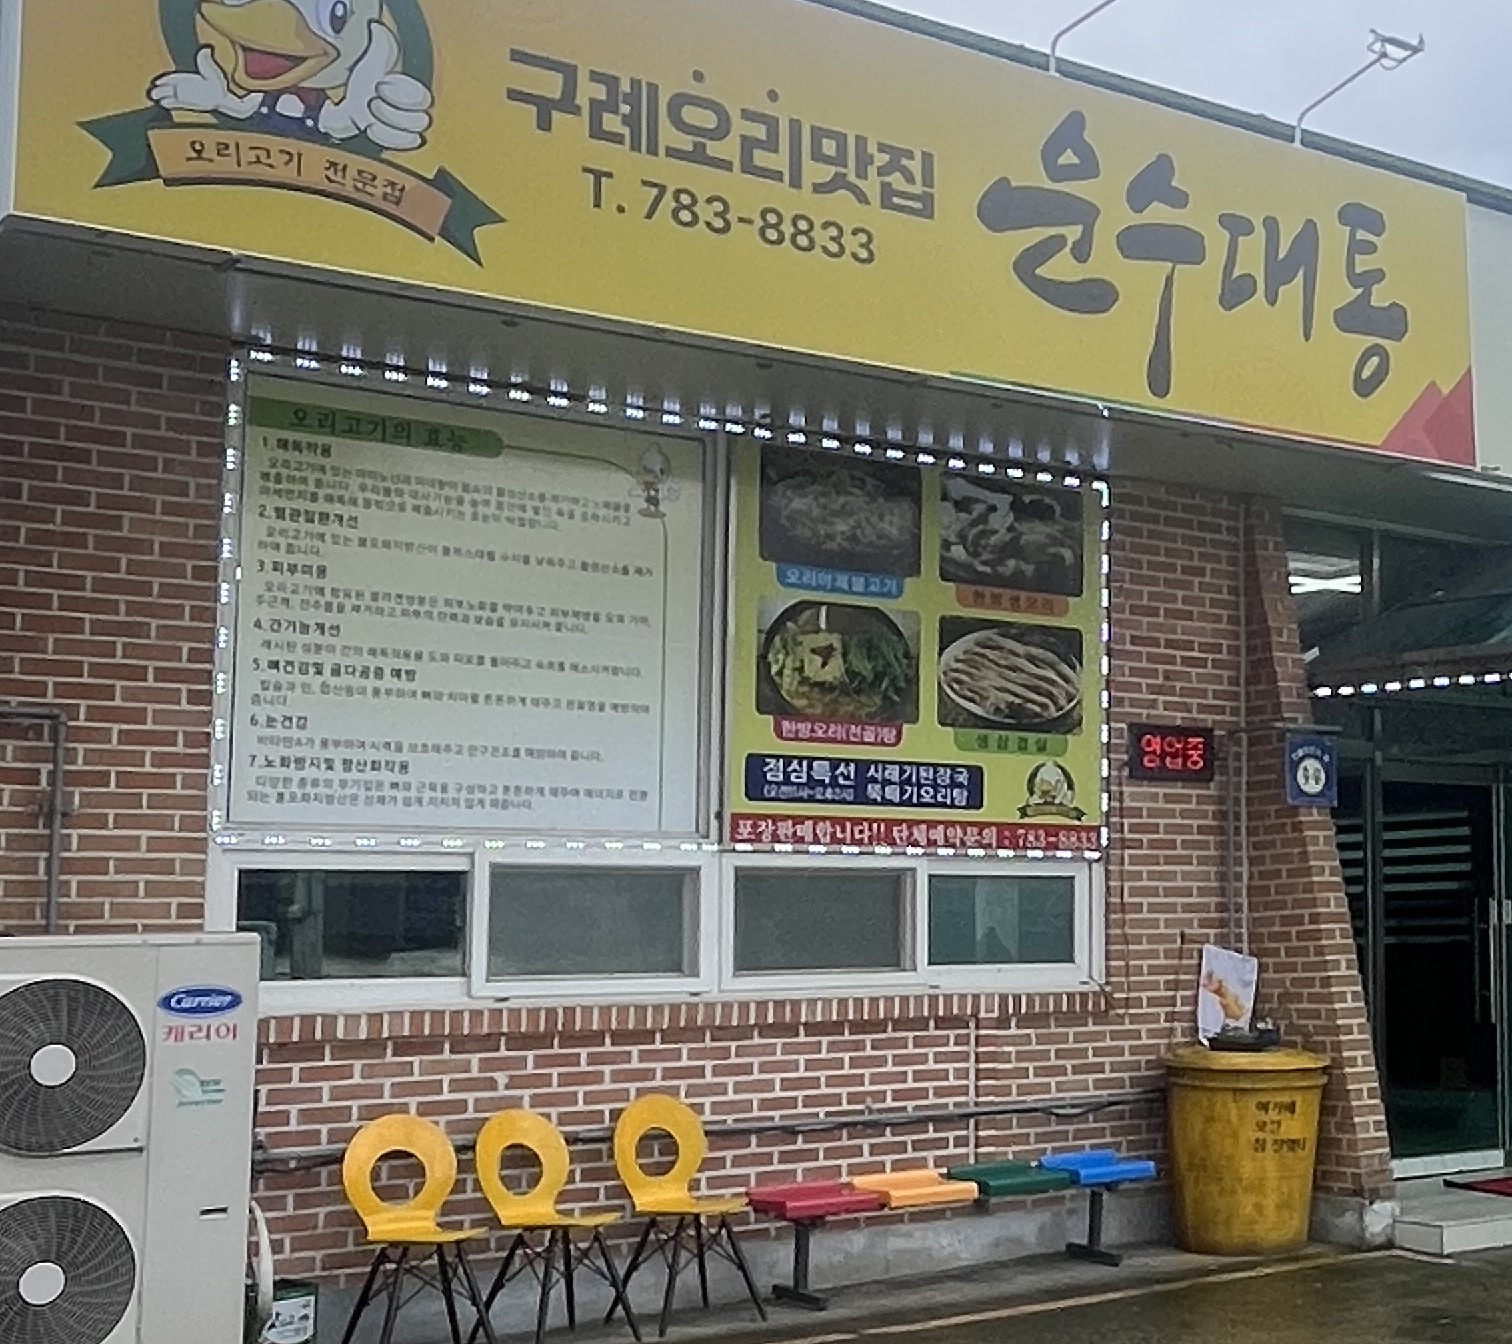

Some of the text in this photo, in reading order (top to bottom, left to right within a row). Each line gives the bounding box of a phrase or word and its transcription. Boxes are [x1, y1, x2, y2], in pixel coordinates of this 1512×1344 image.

[505, 47, 937, 221] 구례오리맛집
[185, 139, 406, 207] 오리고기 전문점
[581, 164, 877, 266] T.783-8833
[976, 110, 1408, 399] 운수대통
[288, 407, 469, 454] 오리고기의 효능
[763, 758, 856, 786] 점심특선
[1140, 734, 1205, 770] 영업중
[171, 994, 231, 1008] Carrier
